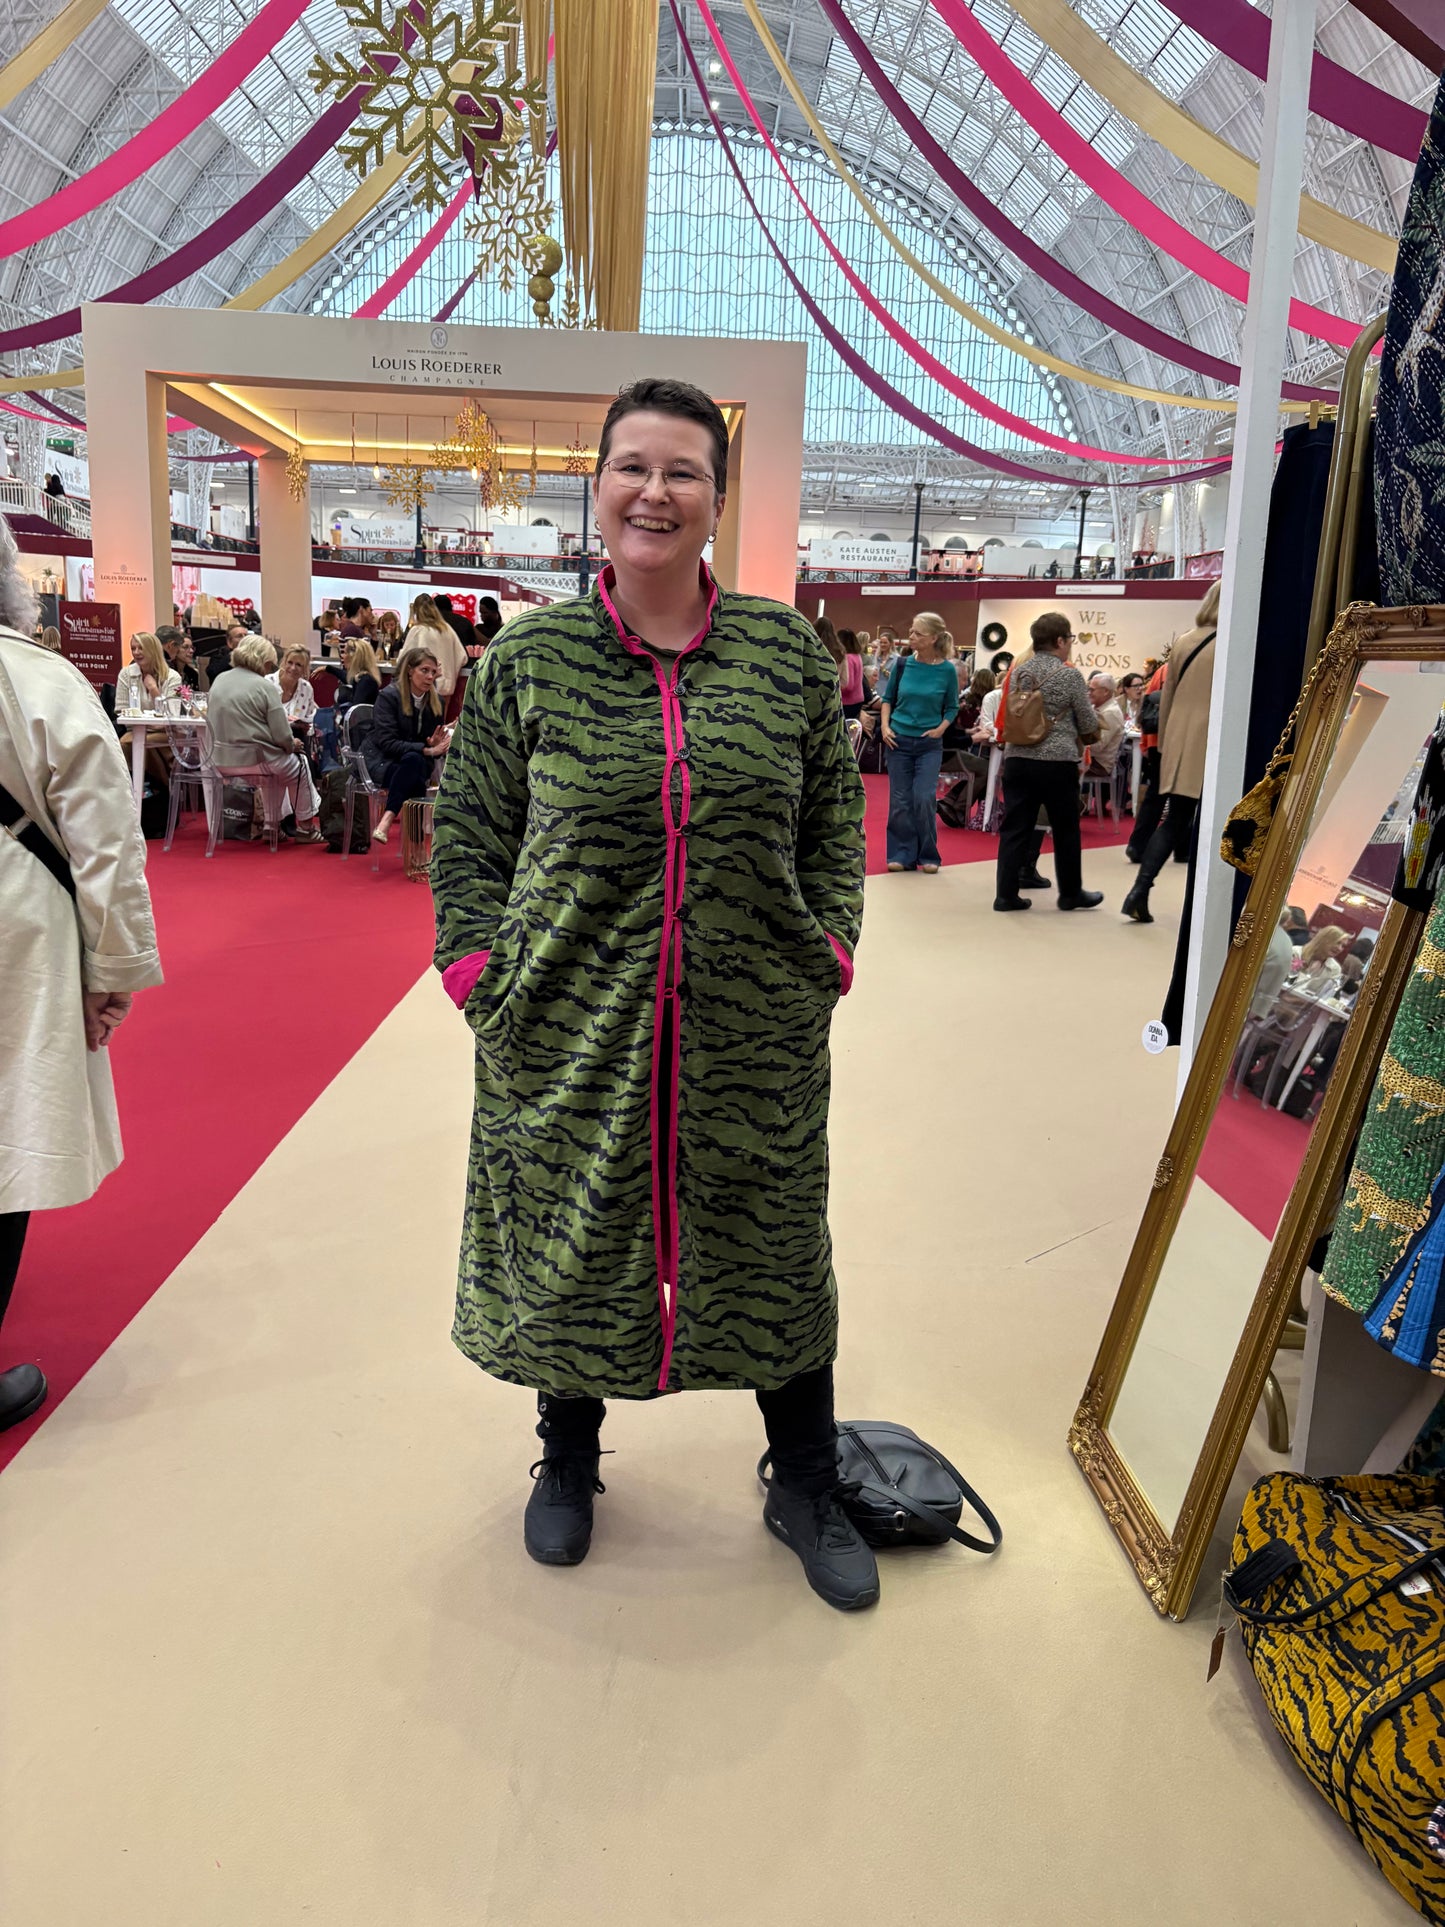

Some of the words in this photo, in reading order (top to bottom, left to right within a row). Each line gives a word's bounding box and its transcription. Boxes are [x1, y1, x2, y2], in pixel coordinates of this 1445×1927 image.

[372, 356, 416, 371] LOUIS
[421, 358, 503, 375] ROEDERER
[389, 375, 485, 386] CHAMPAGNE
[863, 547, 897, 555] AUSTEN
[840, 554, 895, 562] RESTAURANT
[1078, 610, 1107, 626] WE
[1074, 653, 1131, 669] ASONS
